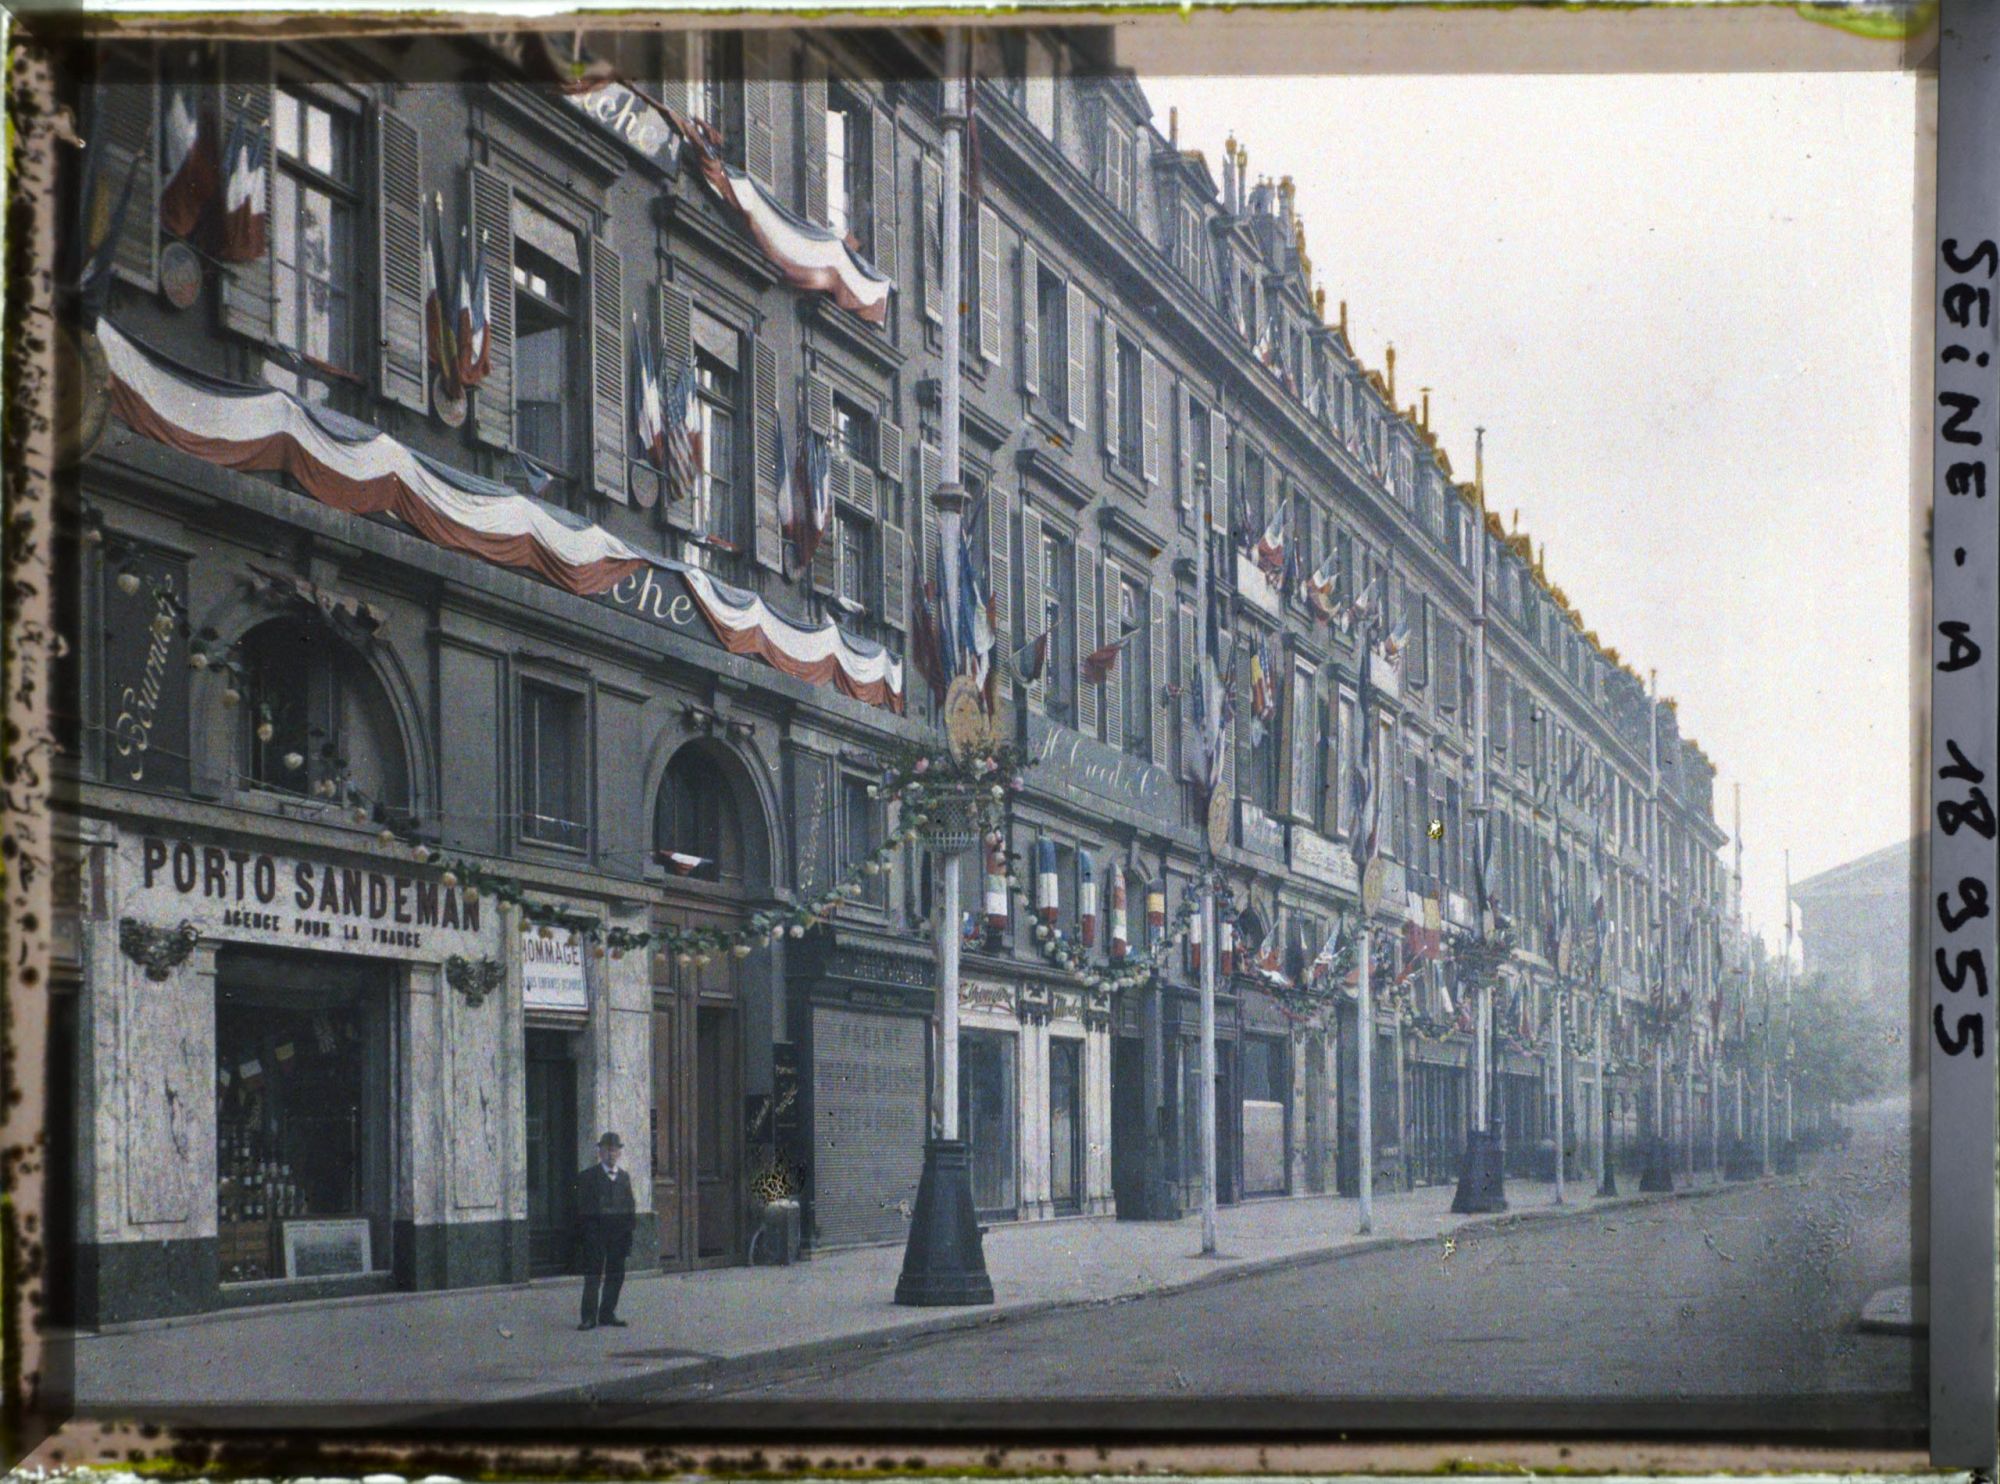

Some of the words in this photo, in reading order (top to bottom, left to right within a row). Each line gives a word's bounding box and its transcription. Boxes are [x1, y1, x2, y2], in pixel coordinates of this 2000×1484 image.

[1936, 620, 1982, 673] A
[144, 839, 276, 904] PORTO
[295, 862, 480, 932] SANDEMAN
[223, 909, 281, 932] AGENCE
[295, 918, 331, 938] POUR
[344, 924, 360, 941] LA
[372, 928, 422, 949] FRANCE
